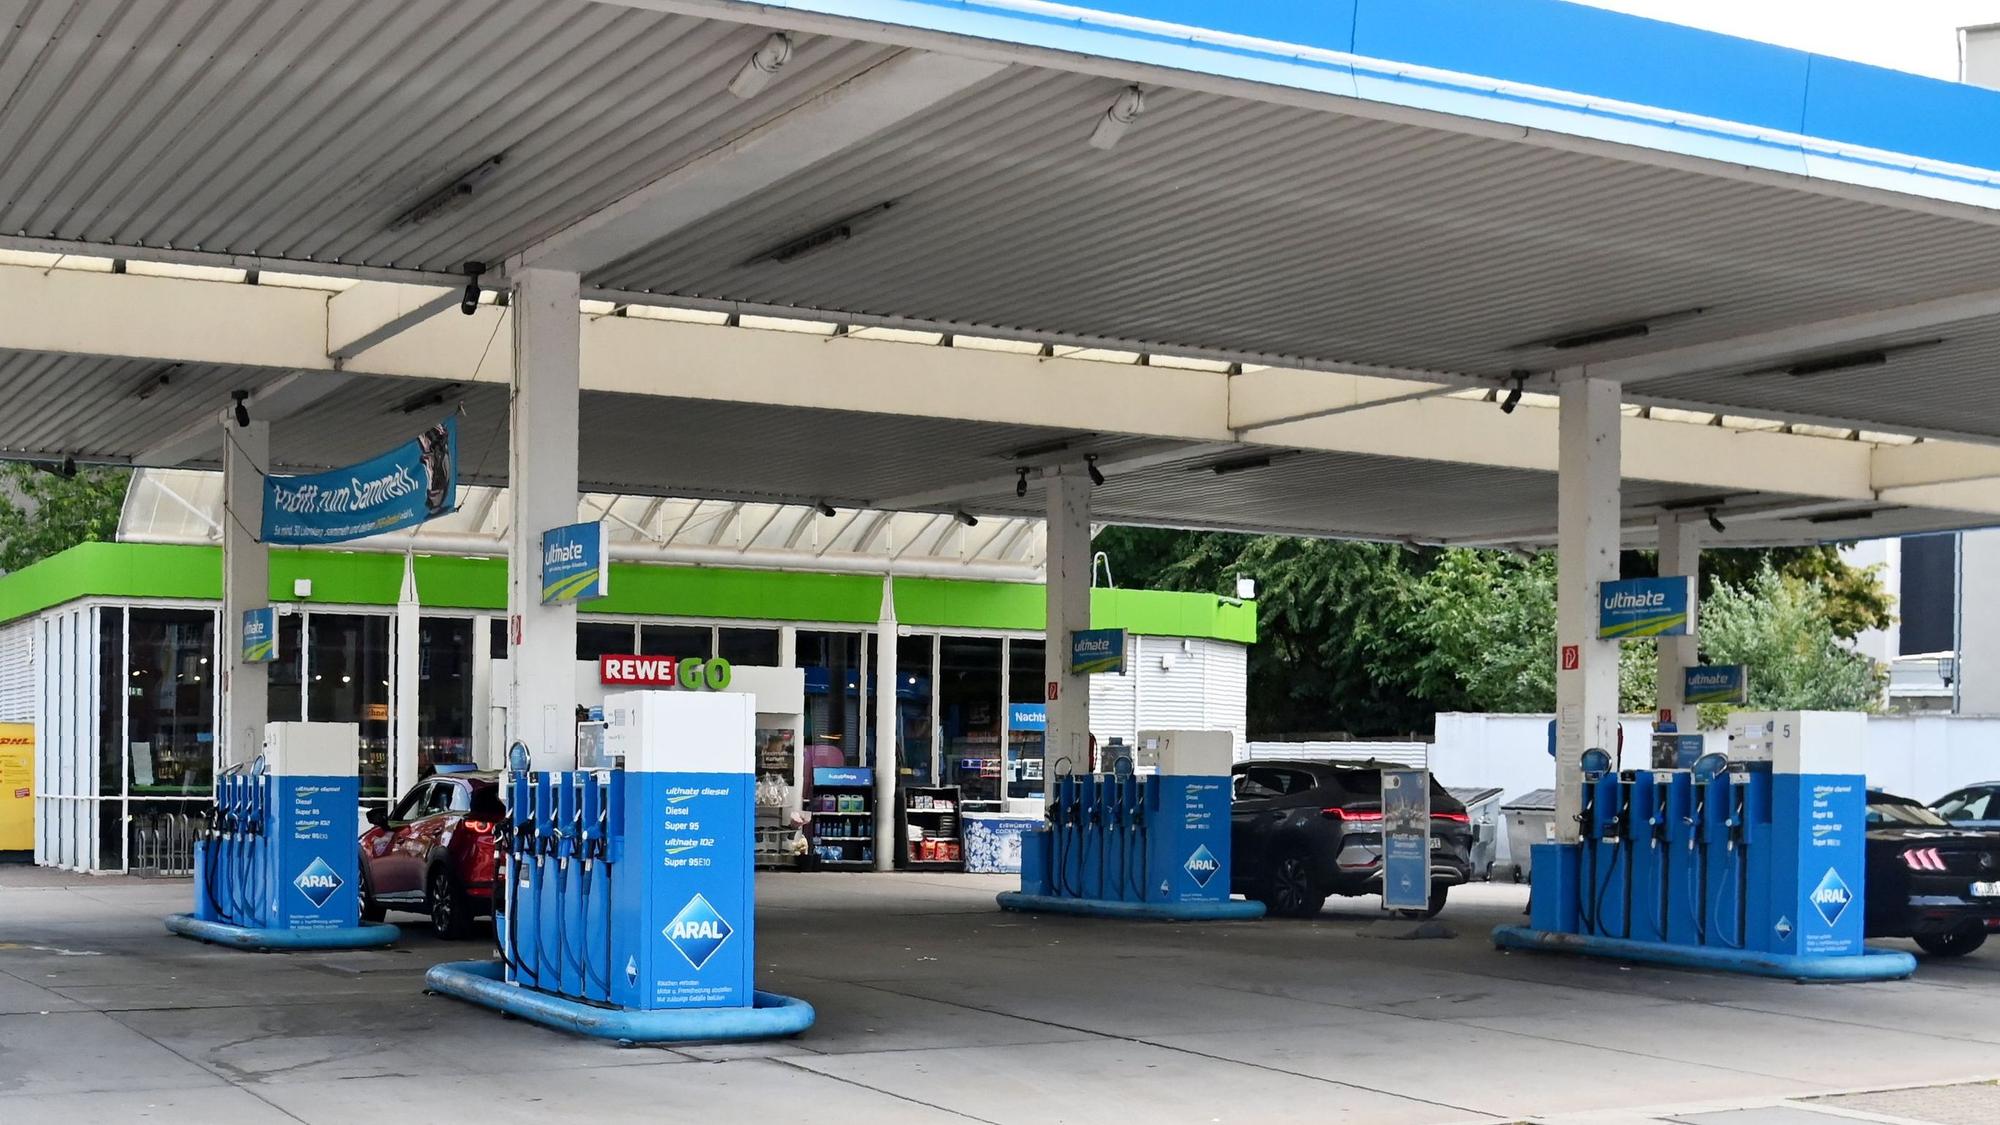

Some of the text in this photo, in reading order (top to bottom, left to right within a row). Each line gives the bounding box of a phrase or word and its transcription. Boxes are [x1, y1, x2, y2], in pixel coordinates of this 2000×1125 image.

[544, 540, 583, 566] ultimate
[1604, 590, 1665, 610] ultimate
[1075, 638, 1110, 652] ultimate
[605, 657, 732, 690] REWE GO
[1687, 673, 1729, 686] ultimate
[1783, 724, 1791, 738] 5
[1165, 739, 1170, 750] 7
[665, 787, 730, 795] ultimate diesel
[665, 806, 689, 815] Diesel
[664, 821, 700, 831] Super 95
[664, 838, 715, 846] ultimate 102
[664, 857, 688, 867] Super
[1189, 860, 1215, 870] ARAL
[300, 875, 337, 888] ARAL
[1816, 888, 1847, 903] ARAL
[671, 921, 723, 940] ARAL
